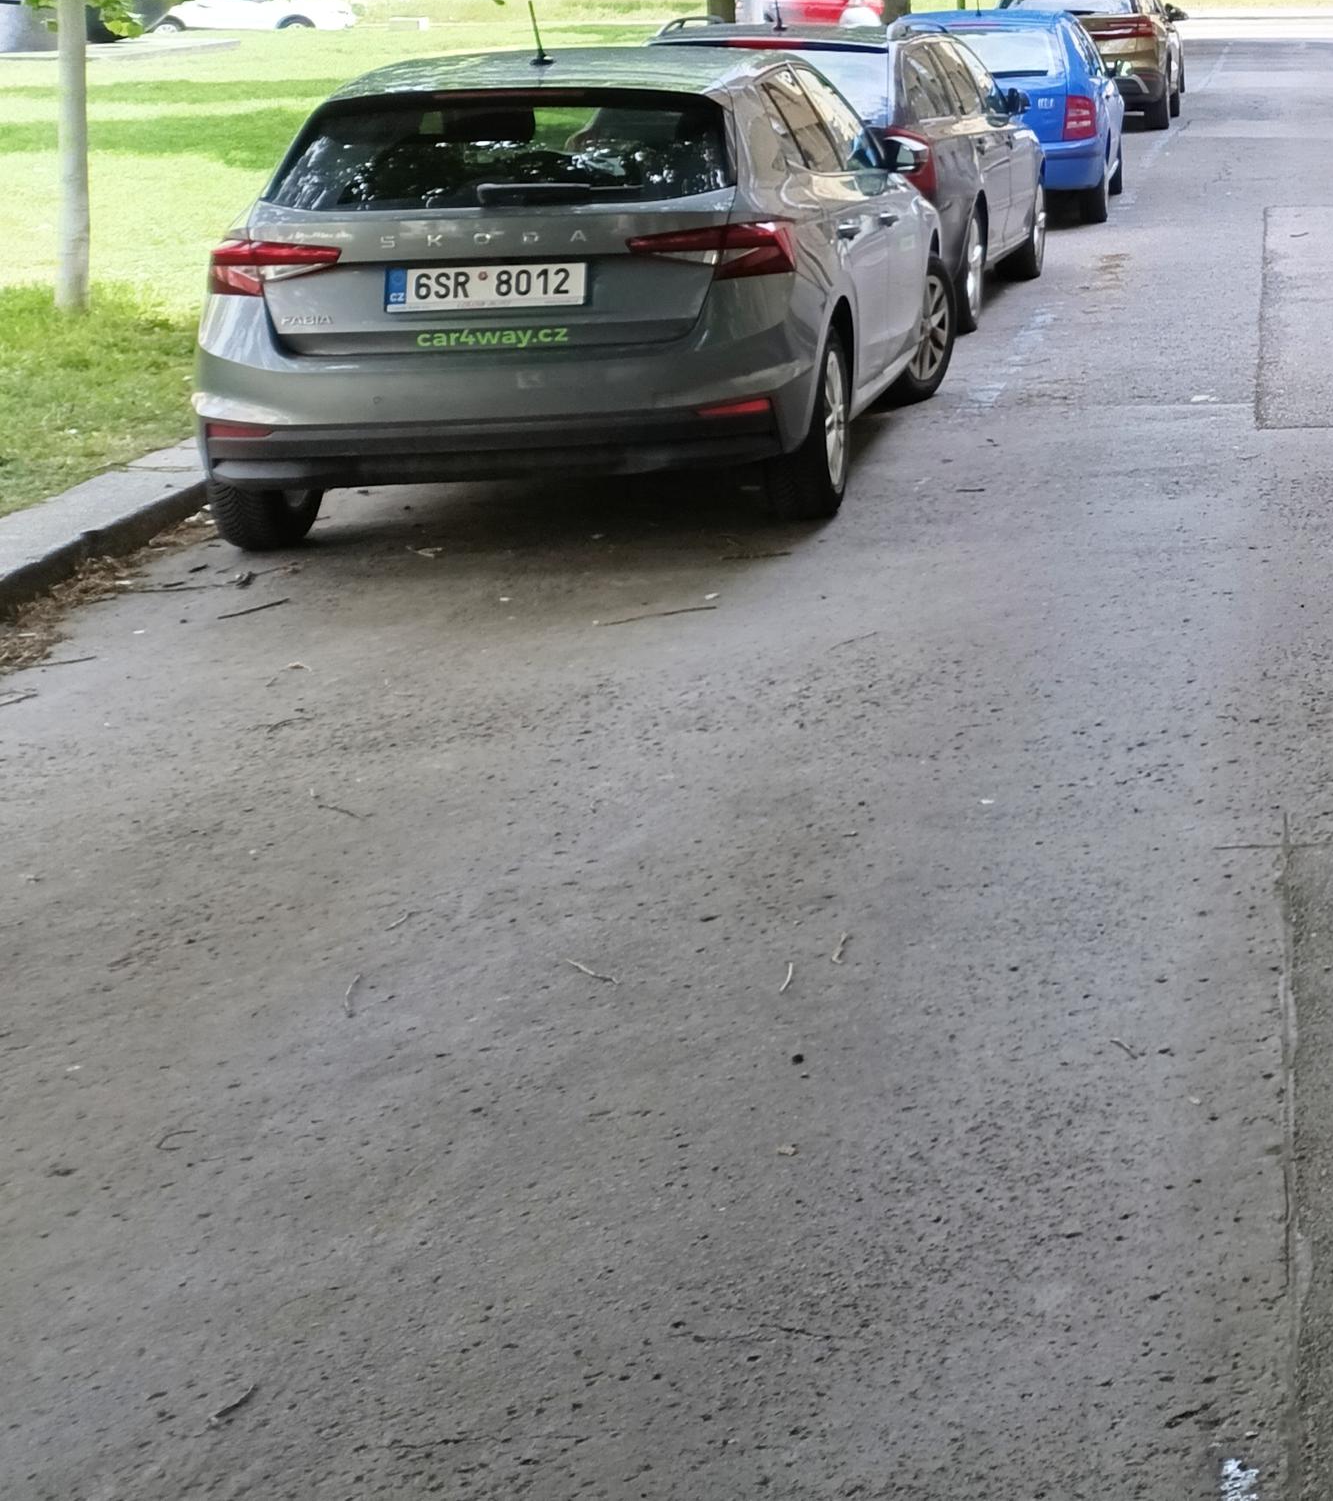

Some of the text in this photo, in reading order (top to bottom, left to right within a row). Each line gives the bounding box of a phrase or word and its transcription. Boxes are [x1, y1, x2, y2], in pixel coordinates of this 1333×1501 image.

[389, 267, 571, 303] CZ 6SR 8012
[281, 314, 333, 326] FABIA
[417, 327, 569, 348] car4way.cz
